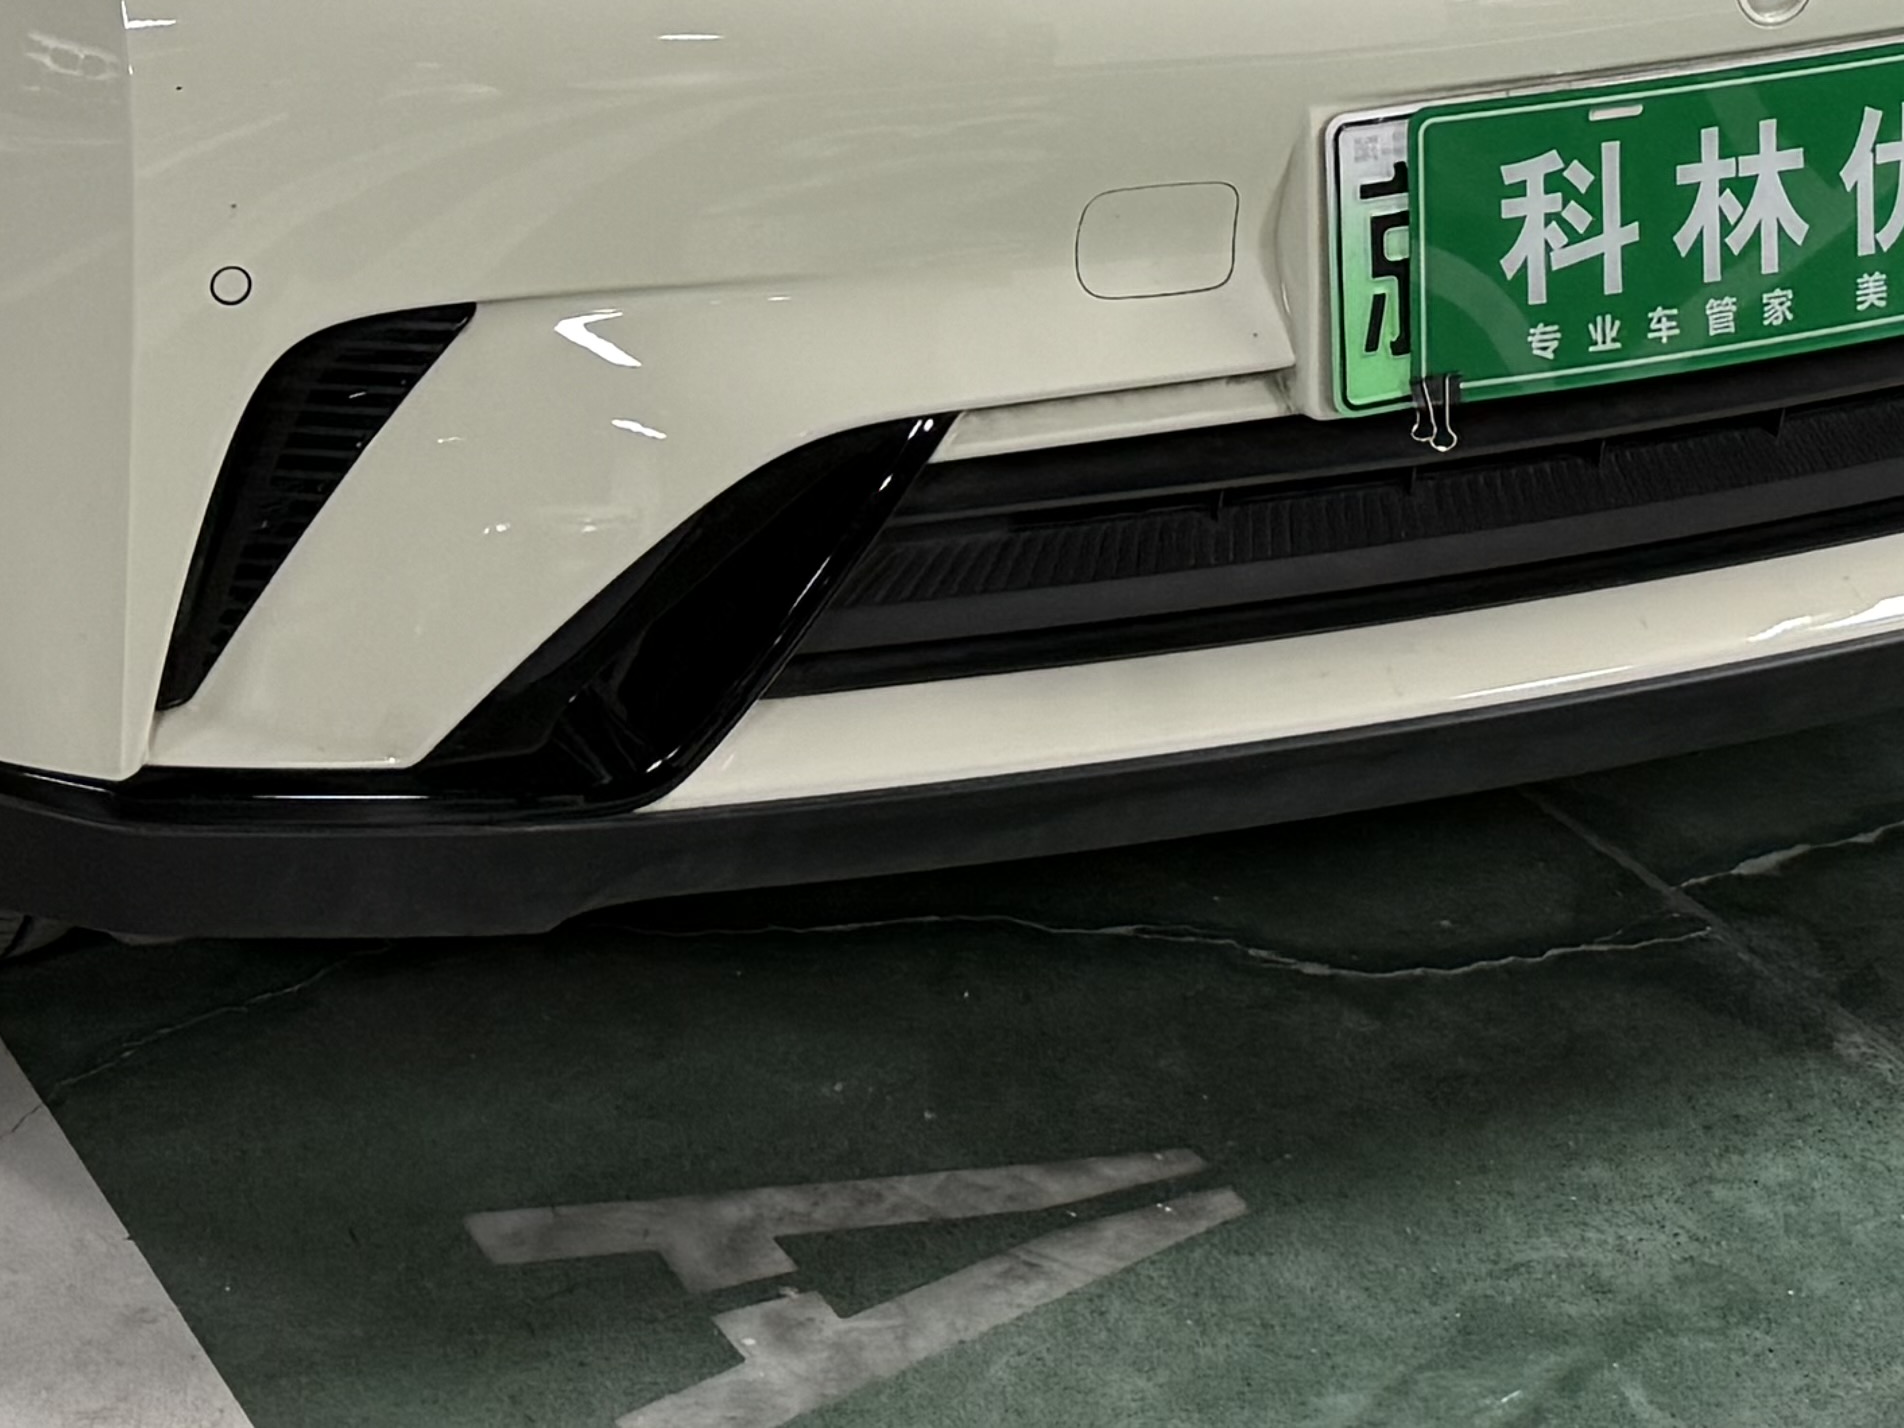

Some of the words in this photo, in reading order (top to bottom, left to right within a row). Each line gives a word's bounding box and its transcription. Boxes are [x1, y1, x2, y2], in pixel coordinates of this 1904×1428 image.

[1527, 288, 1794, 361] 专业车管家
